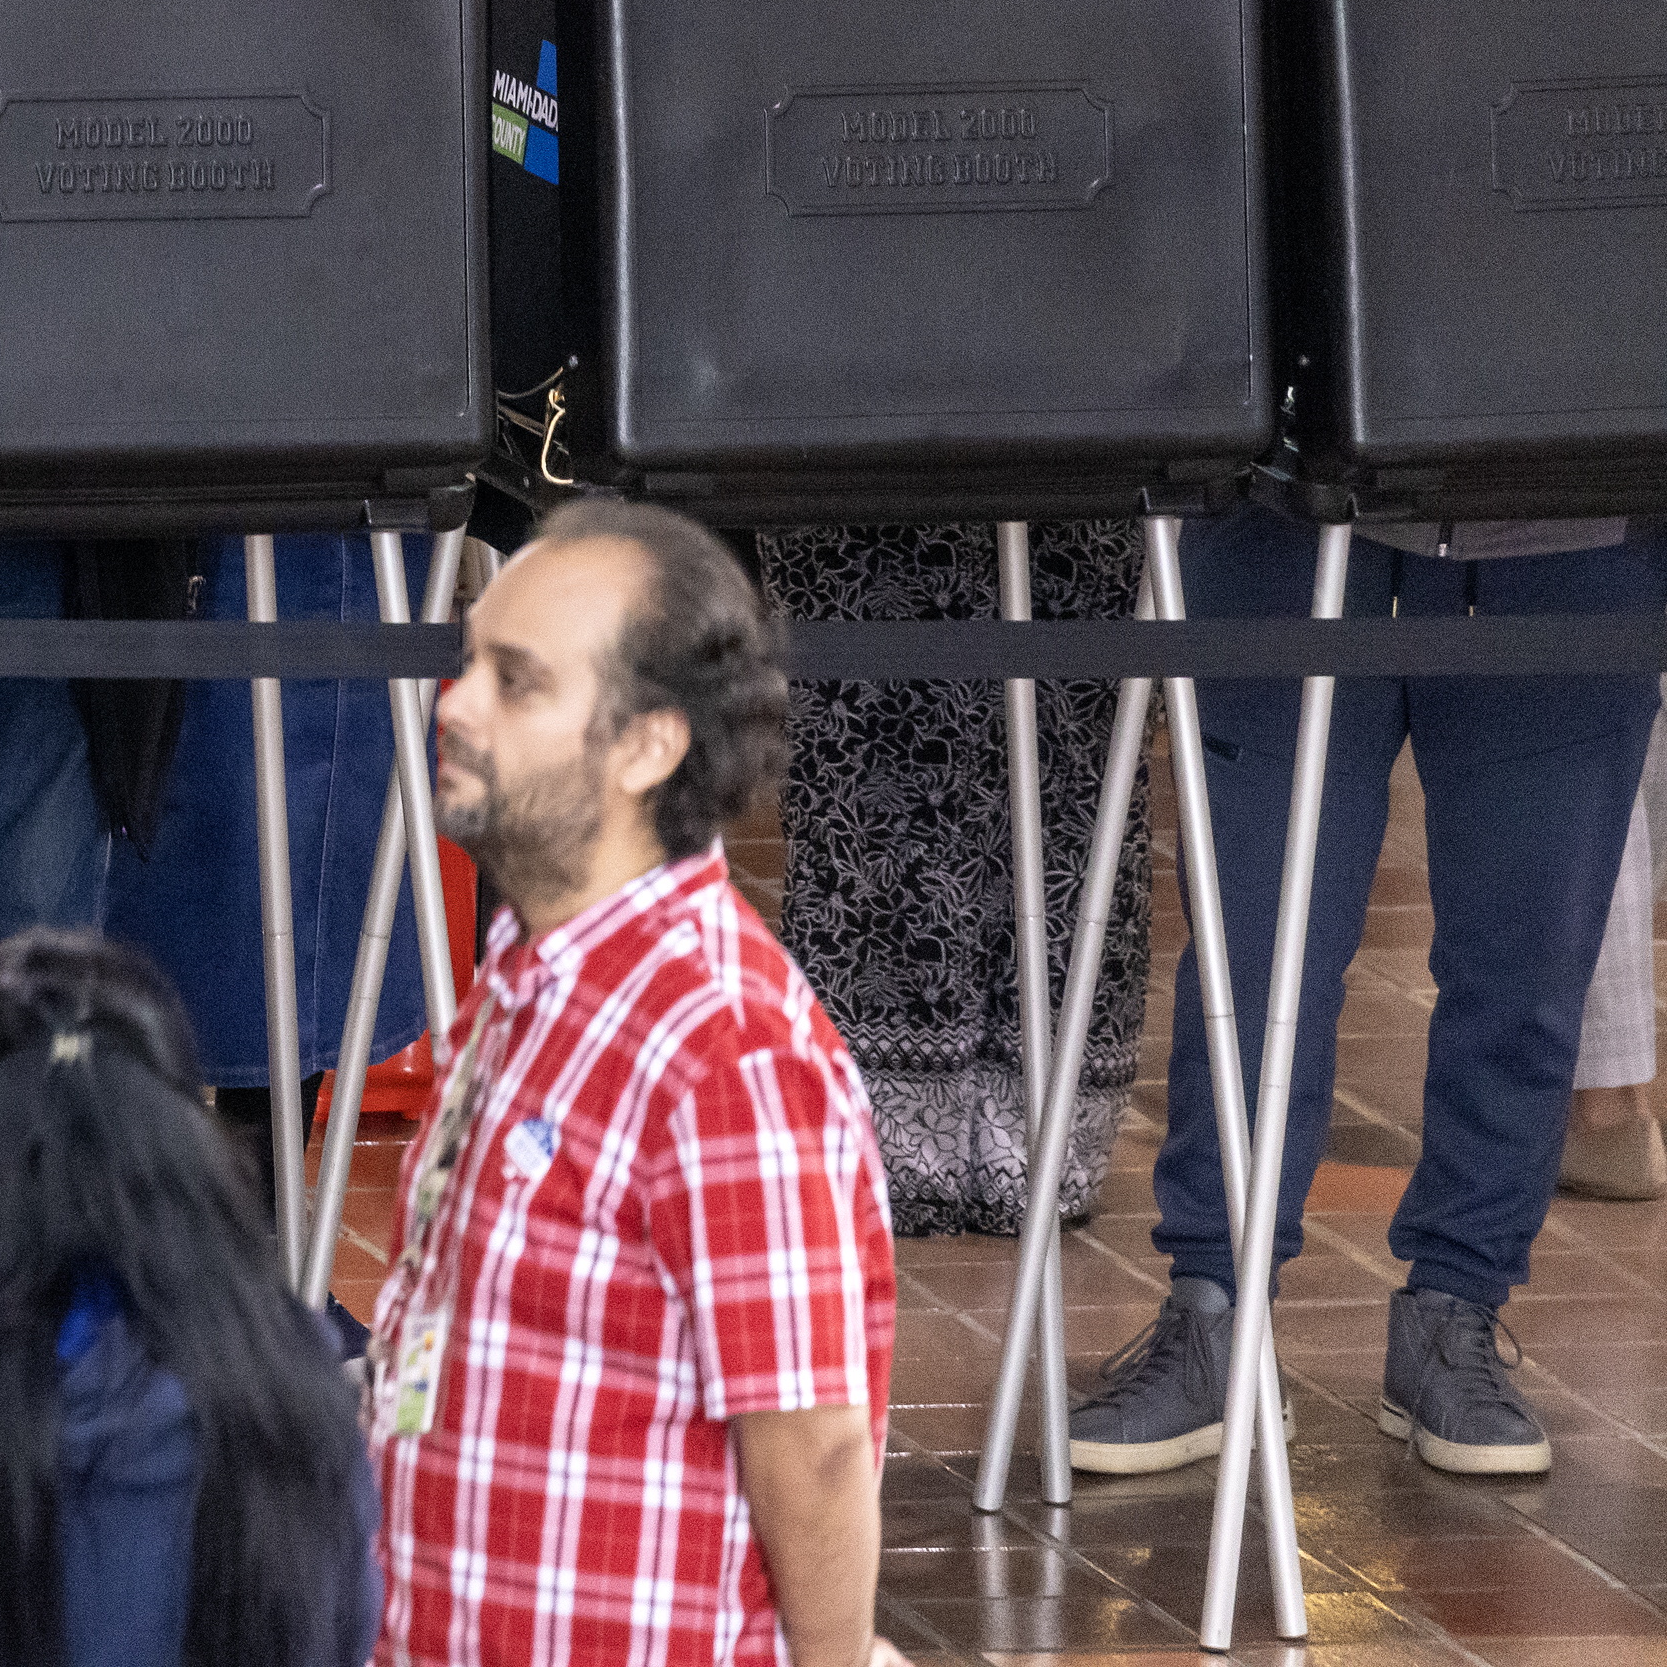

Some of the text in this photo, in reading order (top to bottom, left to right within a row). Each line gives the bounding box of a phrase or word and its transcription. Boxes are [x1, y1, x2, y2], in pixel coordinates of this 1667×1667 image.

[492, 69, 559, 132] MIAMI-DAD
[55, 113, 254, 149] MODEL 2000
[841, 108, 1038, 144] MODEL 2000
[34, 158, 275, 194] VOTING BOOTH
[822, 154, 945, 189] VOTING
